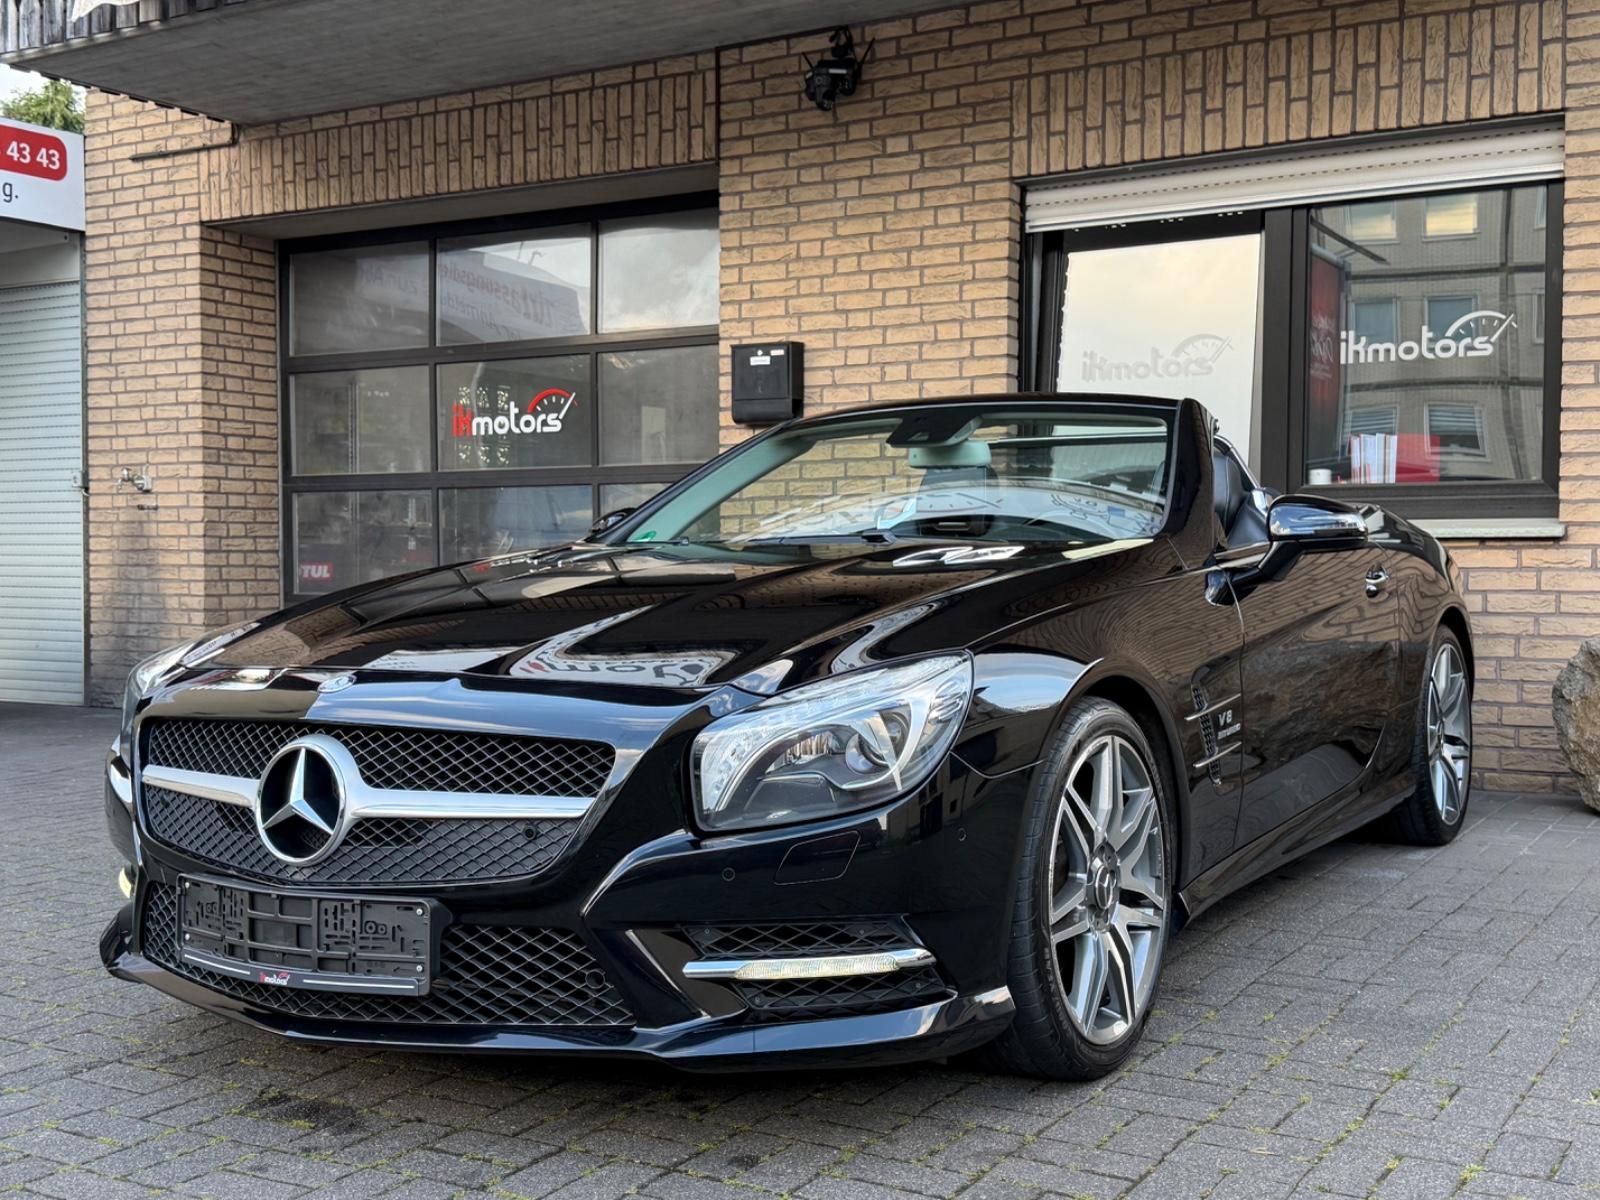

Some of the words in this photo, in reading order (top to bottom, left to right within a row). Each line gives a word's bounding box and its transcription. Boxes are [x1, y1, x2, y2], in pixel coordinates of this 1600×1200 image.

[6, 140, 31, 164] 43
[36, 147, 61, 170] 43
[1340, 325, 1494, 364] ikmotors
[1081, 346, 1213, 383] ikmotors
[452, 401, 562, 436] ikmotors
[300, 564, 331, 578] TUL
